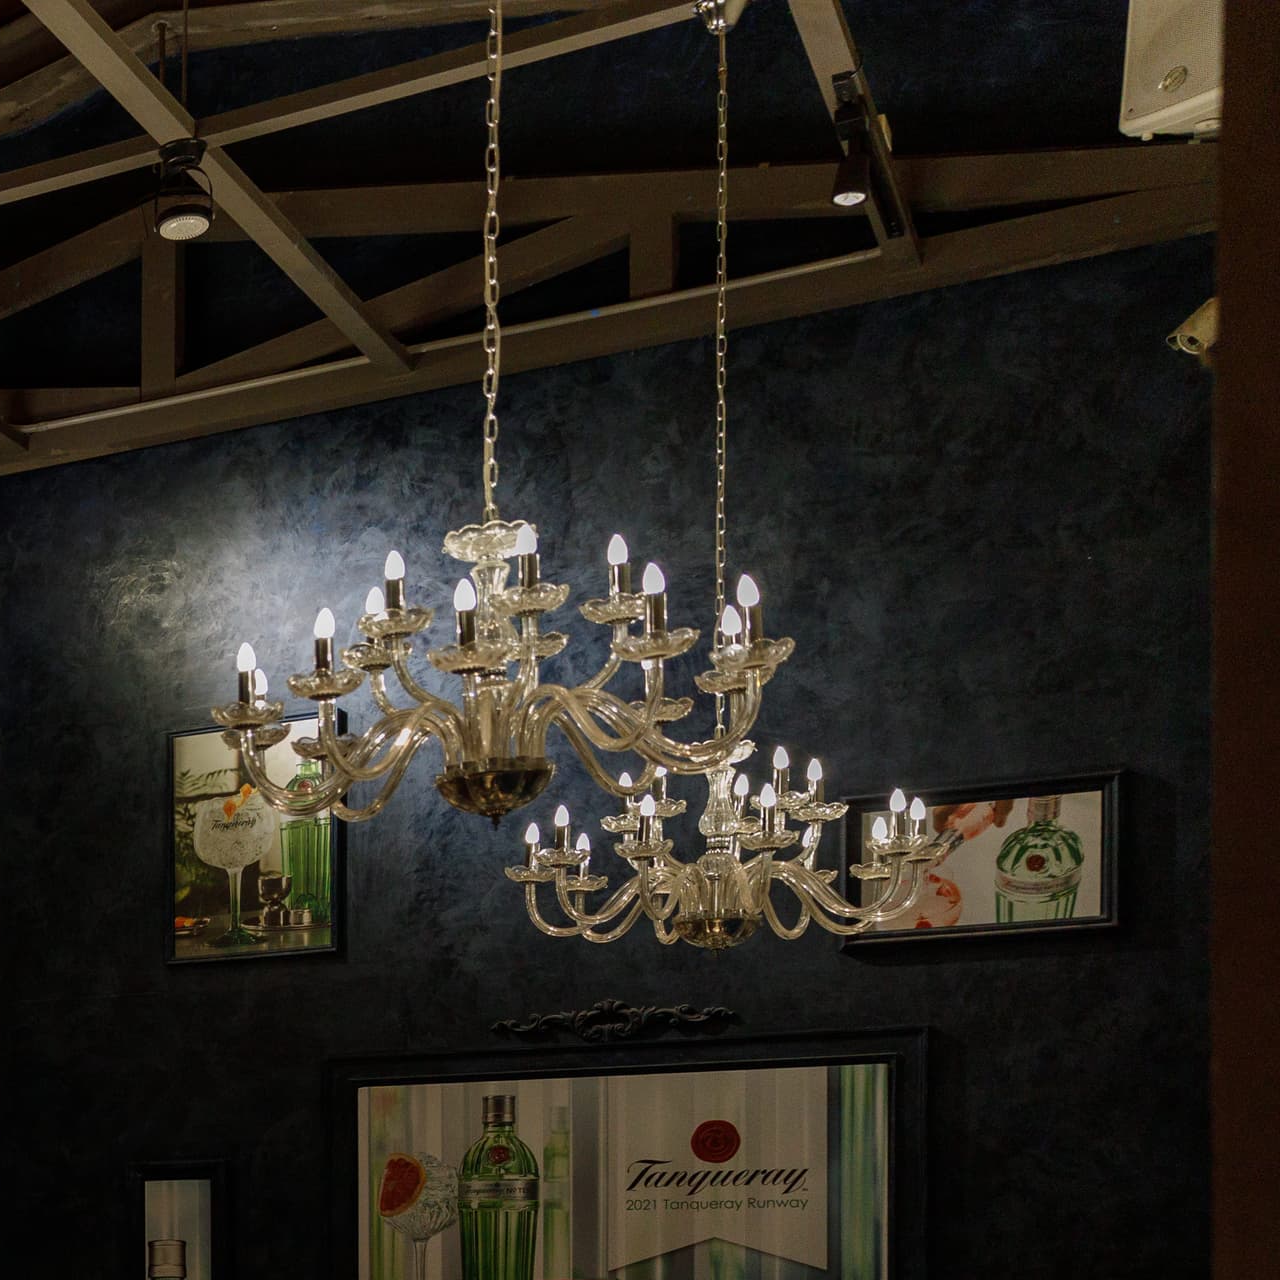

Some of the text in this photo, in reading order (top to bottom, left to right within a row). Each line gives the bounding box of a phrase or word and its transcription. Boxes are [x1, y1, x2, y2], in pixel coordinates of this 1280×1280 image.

[626, 1159, 809, 1196] Tanqueray
[626, 1195, 810, 1213] 2021 Tanqueray Runway
